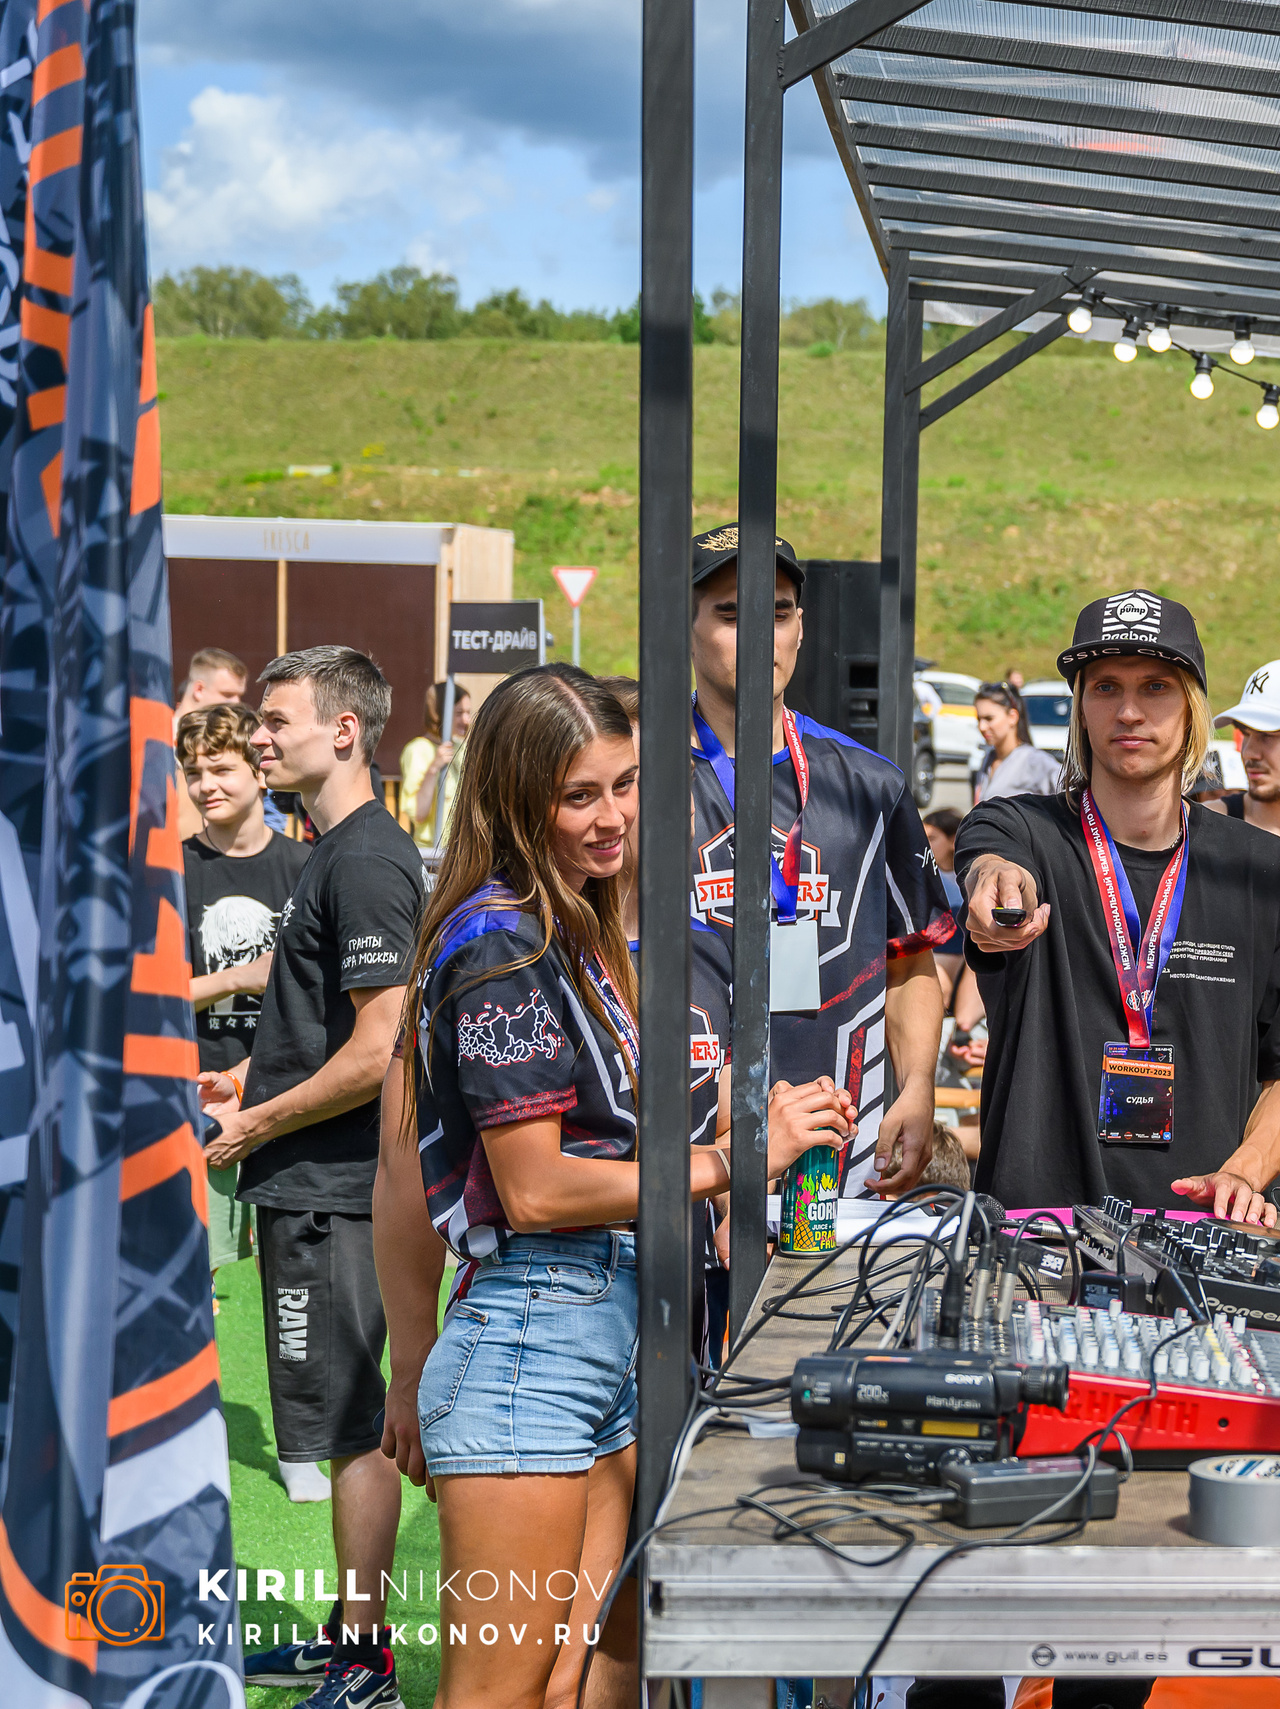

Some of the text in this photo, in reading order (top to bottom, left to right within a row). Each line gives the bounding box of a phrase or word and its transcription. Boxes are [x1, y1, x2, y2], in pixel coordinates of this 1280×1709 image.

[1119, 604, 1146, 615] pump
[452, 627, 538, 653] ТЕСТ-ДРАЙВ
[1087, 812, 1098, 826] ПО
[1090, 827, 1110, 876] ЧЕМПИОНАТ
[1103, 878, 1131, 971] МЕЖРЕГИОНАЛЬНЫЙ
[1146, 878, 1174, 970] МЕЖРЕГИОНАЛЬНЫЙ
[348, 935, 383, 951] ГРАНТЫ
[359, 951, 398, 965] МОСКВЫ
[1109, 1065, 1172, 1077] WORKOUT-2023
[1126, 1096, 1154, 1105] СУДЬЯ
[811, 1223, 828, 1231] JUICE
[279, 1295, 309, 1360] RAW
[944, 1373, 983, 1385] SONY
[925, 1395, 981, 1411] Handycam
[1064, 1649, 1168, 1663] www.guil.es
